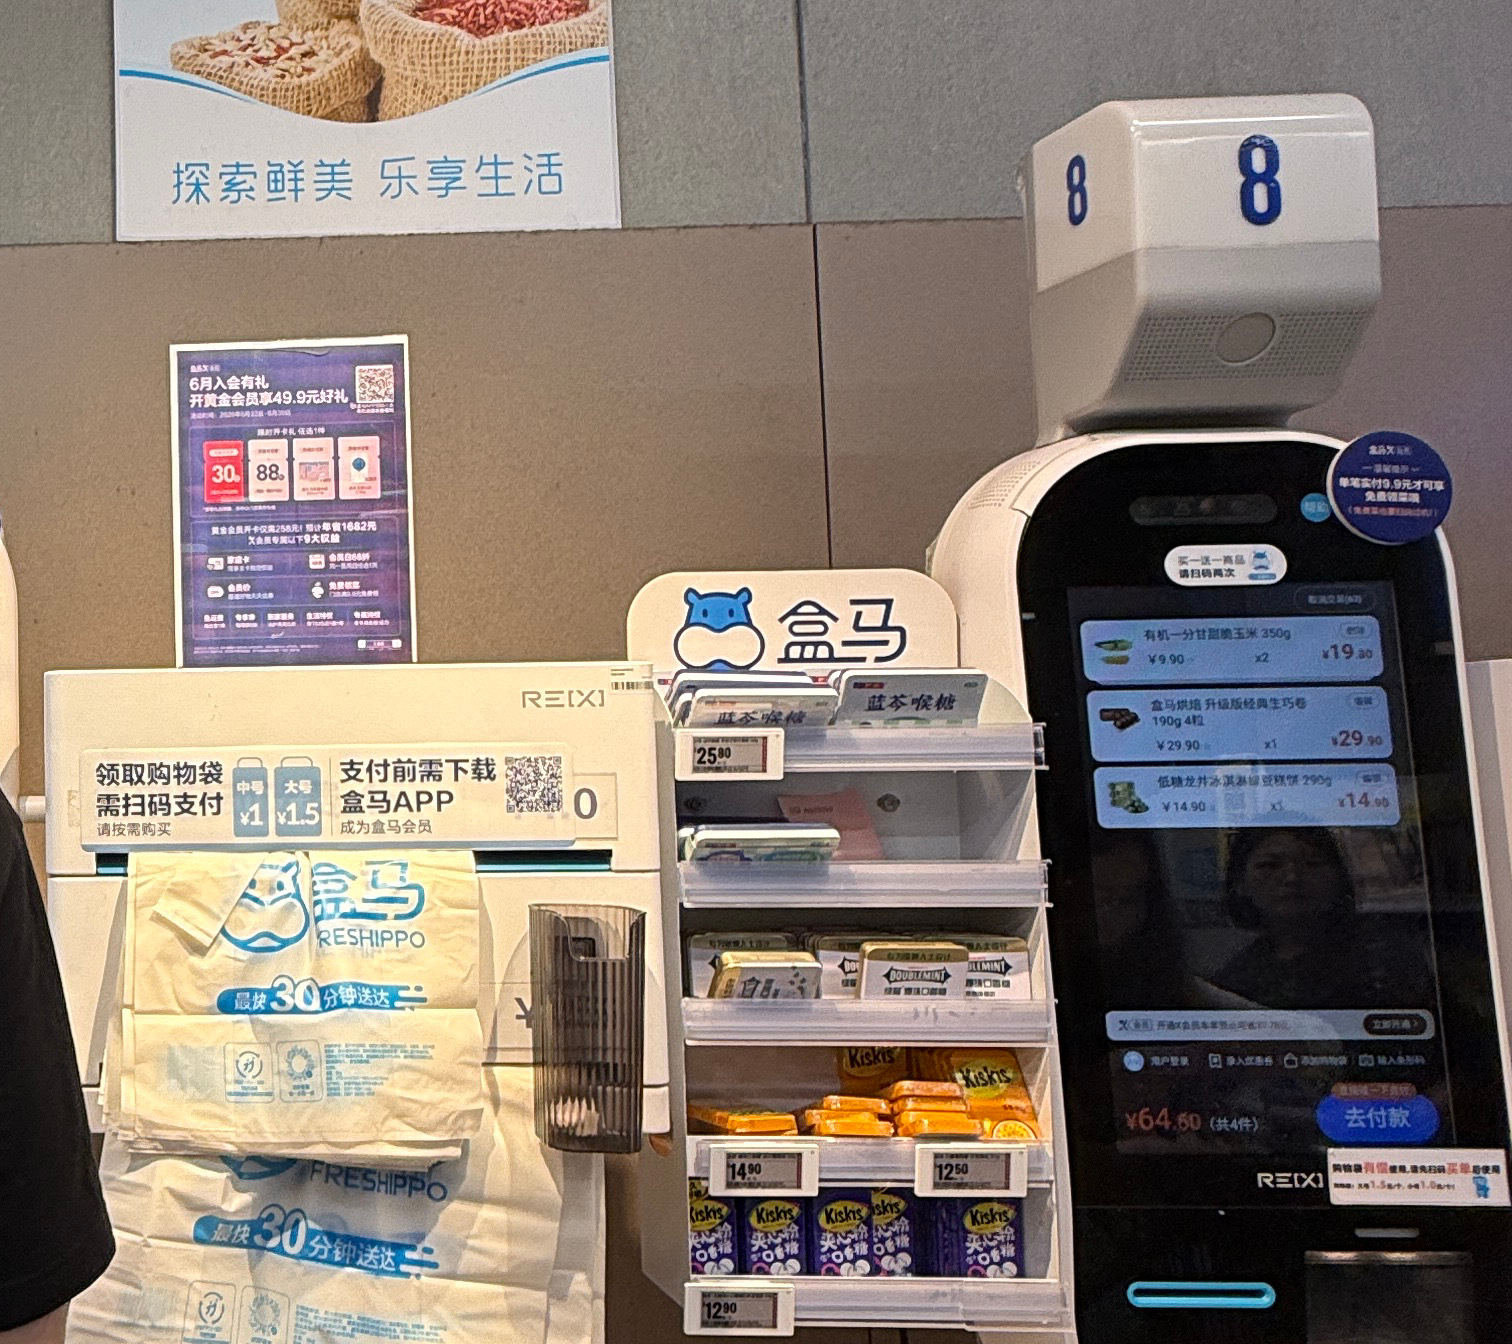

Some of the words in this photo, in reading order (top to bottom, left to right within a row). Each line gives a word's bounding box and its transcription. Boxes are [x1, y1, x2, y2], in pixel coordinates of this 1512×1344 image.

[171, 159, 353, 205] 探索鲜美
[378, 152, 564, 199] 乐享生活
[1067, 154, 1088, 226] 8
[1238, 134, 1282, 225] 8
[189, 375, 269, 391] 6月入会有礼
[189, 389, 348, 408] 开黄金会员享49.9元好礼
[211, 464, 235, 483] 30
[256, 464, 279, 481] 88
[777, 598, 907, 664] 盒马
[1262, 629, 1291, 641] 350g
[866, 693, 957, 713] 蓝芩喉糖
[1153, 716, 1181, 727] 190g
[95, 760, 224, 787] 领取购物袋
[339, 756, 497, 784] 支付前需下载
[236, 780, 265, 796] 中号
[284, 780, 312, 795] 大号
[95, 790, 224, 818] 需扫码支付
[339, 789, 455, 815] 盒马APP
[240, 802, 264, 826] ¥1
[277, 802, 320, 826] ¥1.5
[96, 821, 172, 837] 请按需购买
[340, 818, 433, 836] 成为盒马会员
[312, 860, 425, 921] 盒马
[317, 927, 426, 950] RESHIPPO
[889, 970, 945, 982] DOUBLEMINT
[1126, 1107, 1201, 1131] ¥64.60
[1345, 1106, 1411, 1129] 去付款
[309, 1160, 448, 1203] FRESHIPPO
